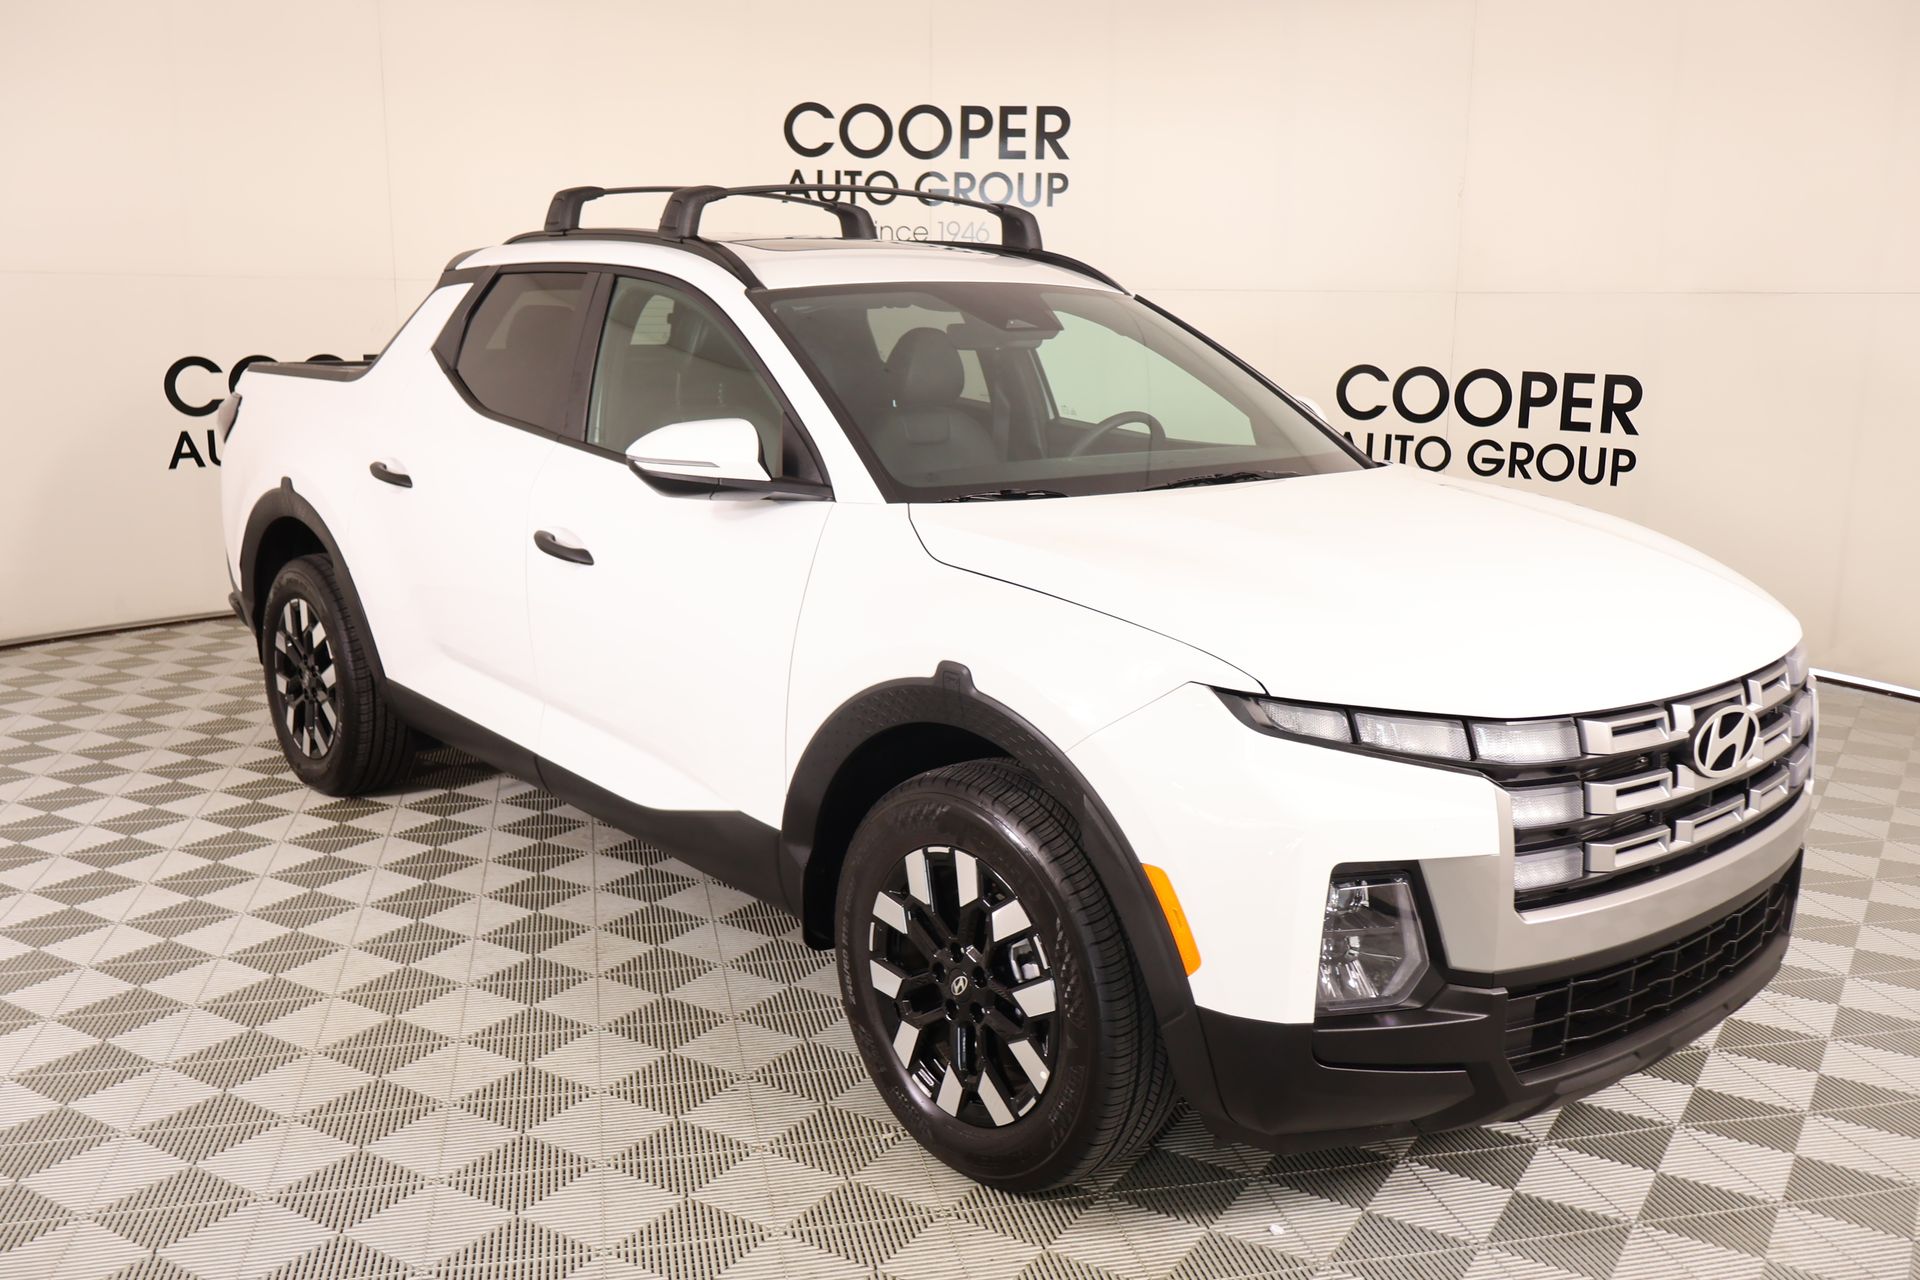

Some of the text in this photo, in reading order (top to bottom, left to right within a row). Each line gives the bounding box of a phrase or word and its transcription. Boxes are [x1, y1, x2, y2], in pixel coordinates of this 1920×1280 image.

[784, 101, 1071, 160] COOPER
[783, 169, 1069, 207] AUTO GROUP
[937, 220, 990, 242] 1946
[1336, 364, 1643, 436] COOPER
[1343, 431, 1637, 487] UTO GROUP
